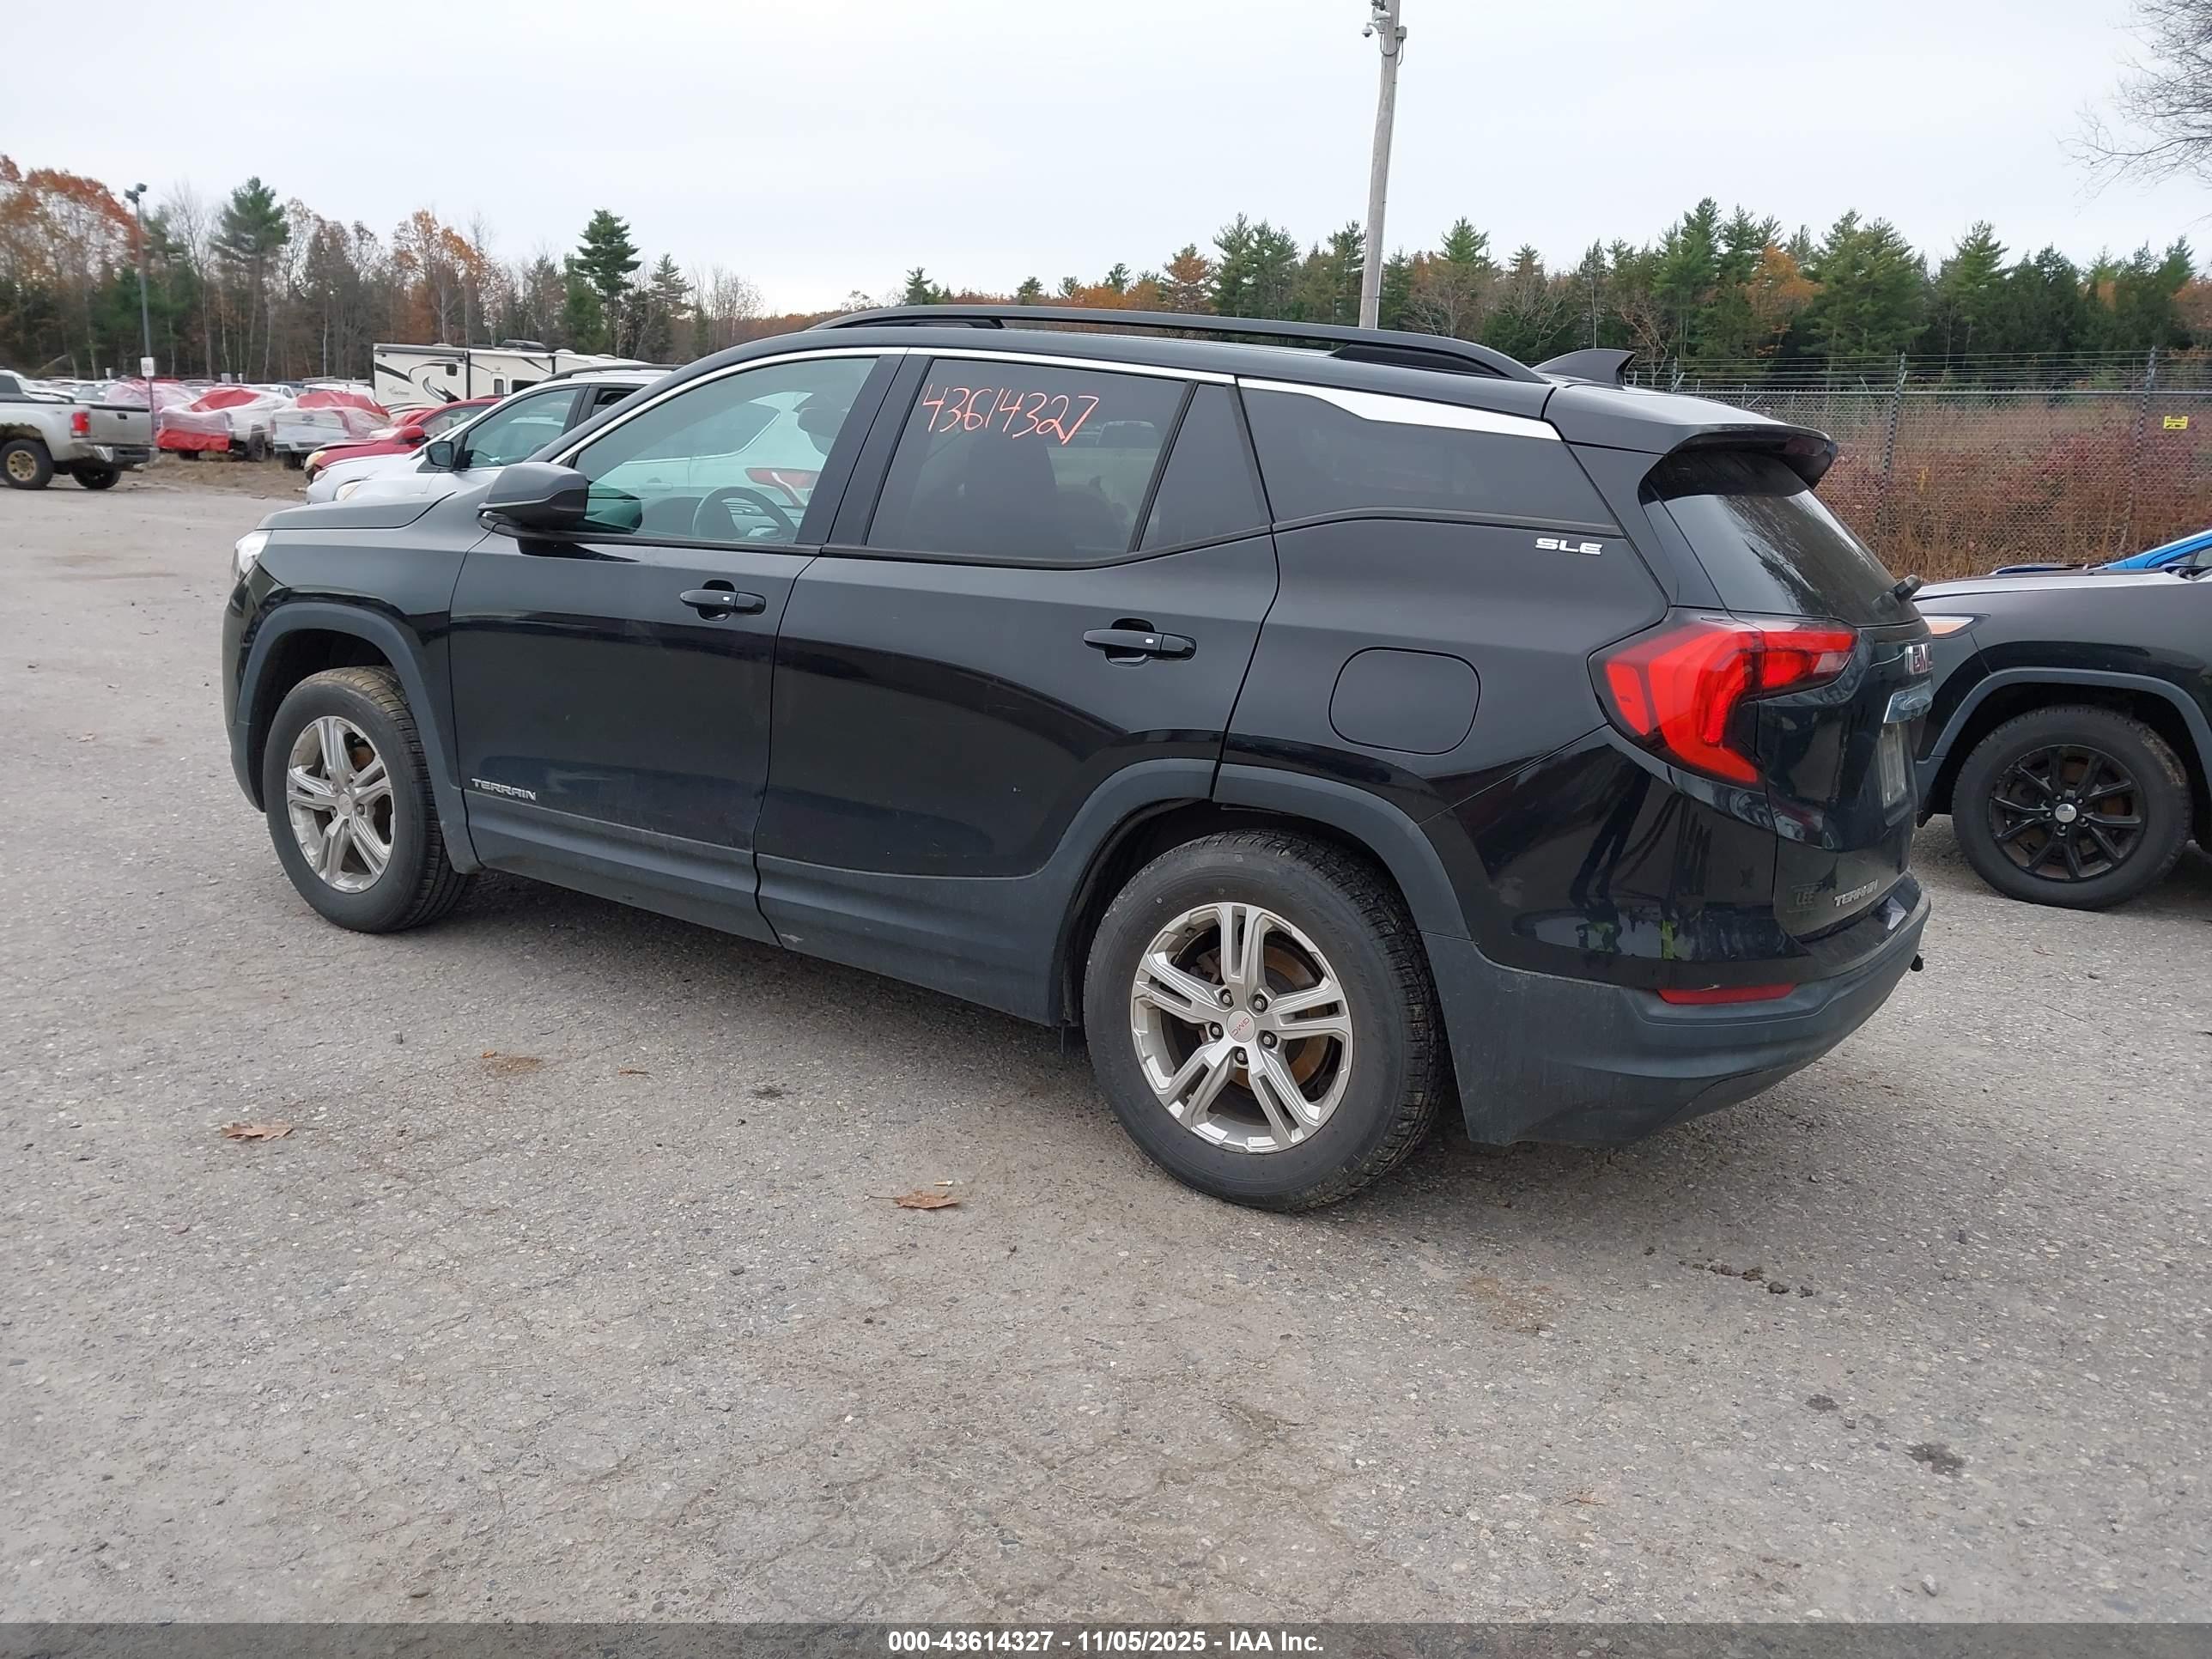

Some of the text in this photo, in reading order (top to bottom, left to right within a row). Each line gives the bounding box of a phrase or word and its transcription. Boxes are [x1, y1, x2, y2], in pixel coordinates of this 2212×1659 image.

[922, 383, 1100, 446] 43614327
[1535, 538, 1603, 556] SLE
[471, 777, 537, 802] TERRAIN
[1231, 1017, 1250, 1036] GMC
